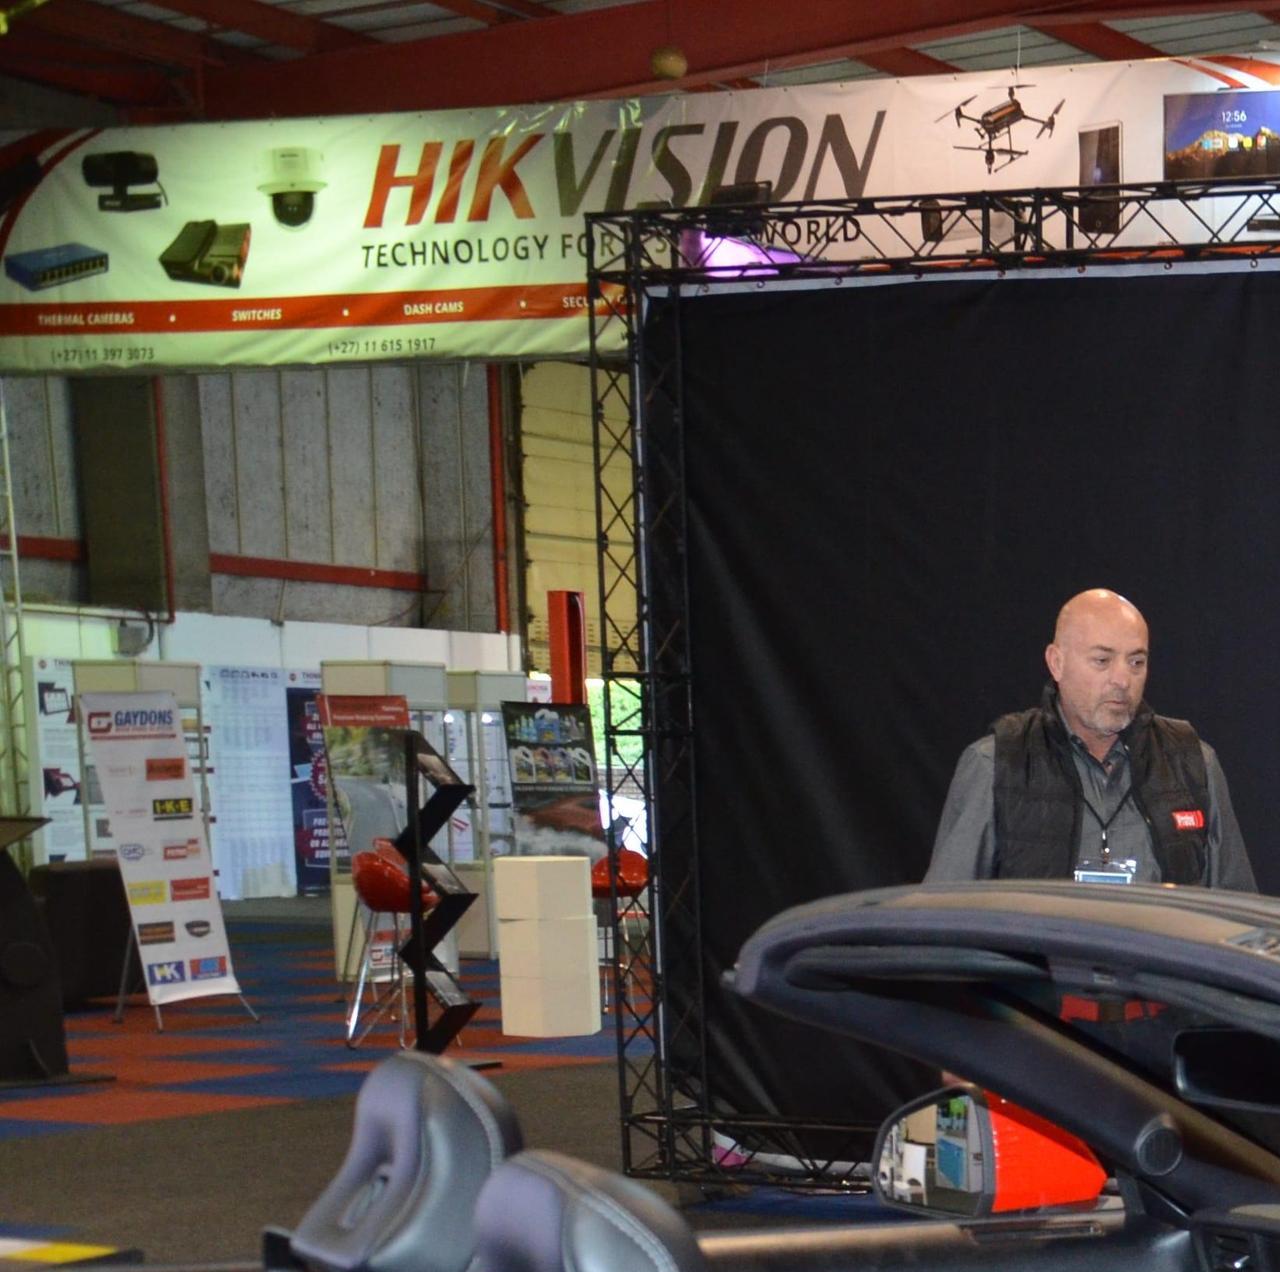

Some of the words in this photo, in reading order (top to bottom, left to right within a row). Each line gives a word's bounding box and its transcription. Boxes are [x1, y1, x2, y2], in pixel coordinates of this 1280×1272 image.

[1221, 110, 1248, 122] 12:56
[363, 109, 888, 229] HIKVISION
[362, 235, 549, 268] TECHNOLOGY
[232, 309, 282, 322] SWITCHES
[403, 303, 433, 316] DASH
[435, 301, 464, 314] CAMS
[38, 314, 85, 326] THERMAL
[87, 312, 134, 325] CAMERAS
[103, 348, 122, 360] 397
[127, 347, 154, 360] 3073
[328, 342, 359, 355] (+27)
[364, 341, 377, 353] 11
[381, 339, 402, 352] 615
[408, 337, 436, 351] 1917
[115, 710, 173, 727] GAYDONS
